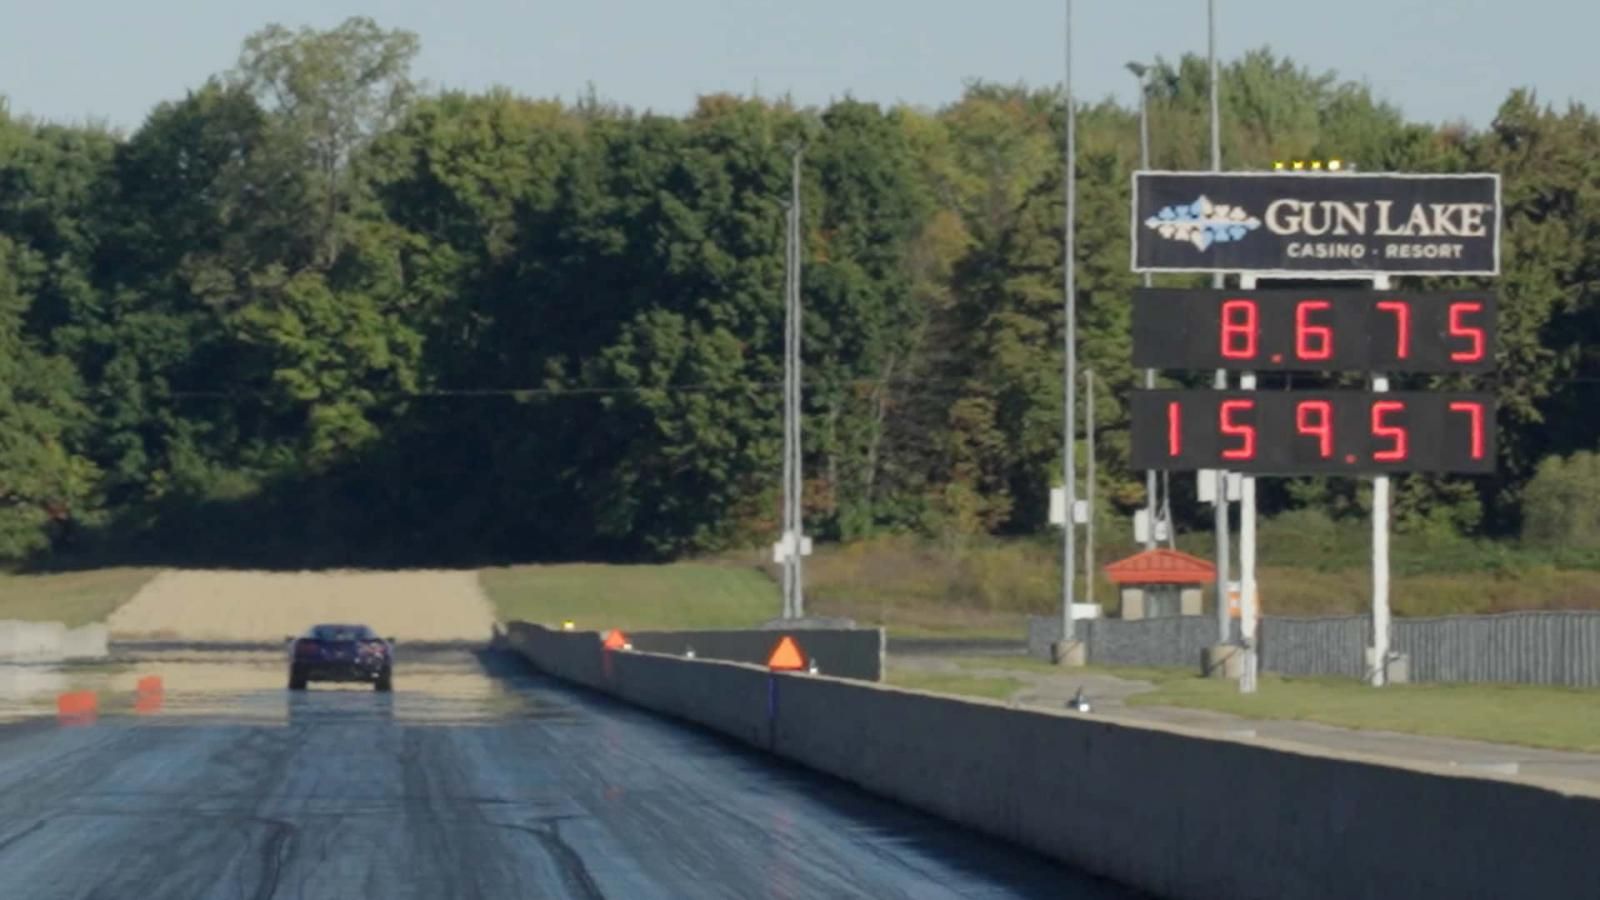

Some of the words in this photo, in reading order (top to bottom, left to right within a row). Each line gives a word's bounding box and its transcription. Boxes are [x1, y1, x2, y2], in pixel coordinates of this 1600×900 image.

[1265, 199, 1368, 236] GUN
[1375, 200, 1486, 237] LAKE
[1287, 242, 1365, 258] CASINO
[1385, 243, 1463, 259] RESORT
[1220, 300, 1485, 362] 8.675
[1167, 400, 1485, 461] 159.57
